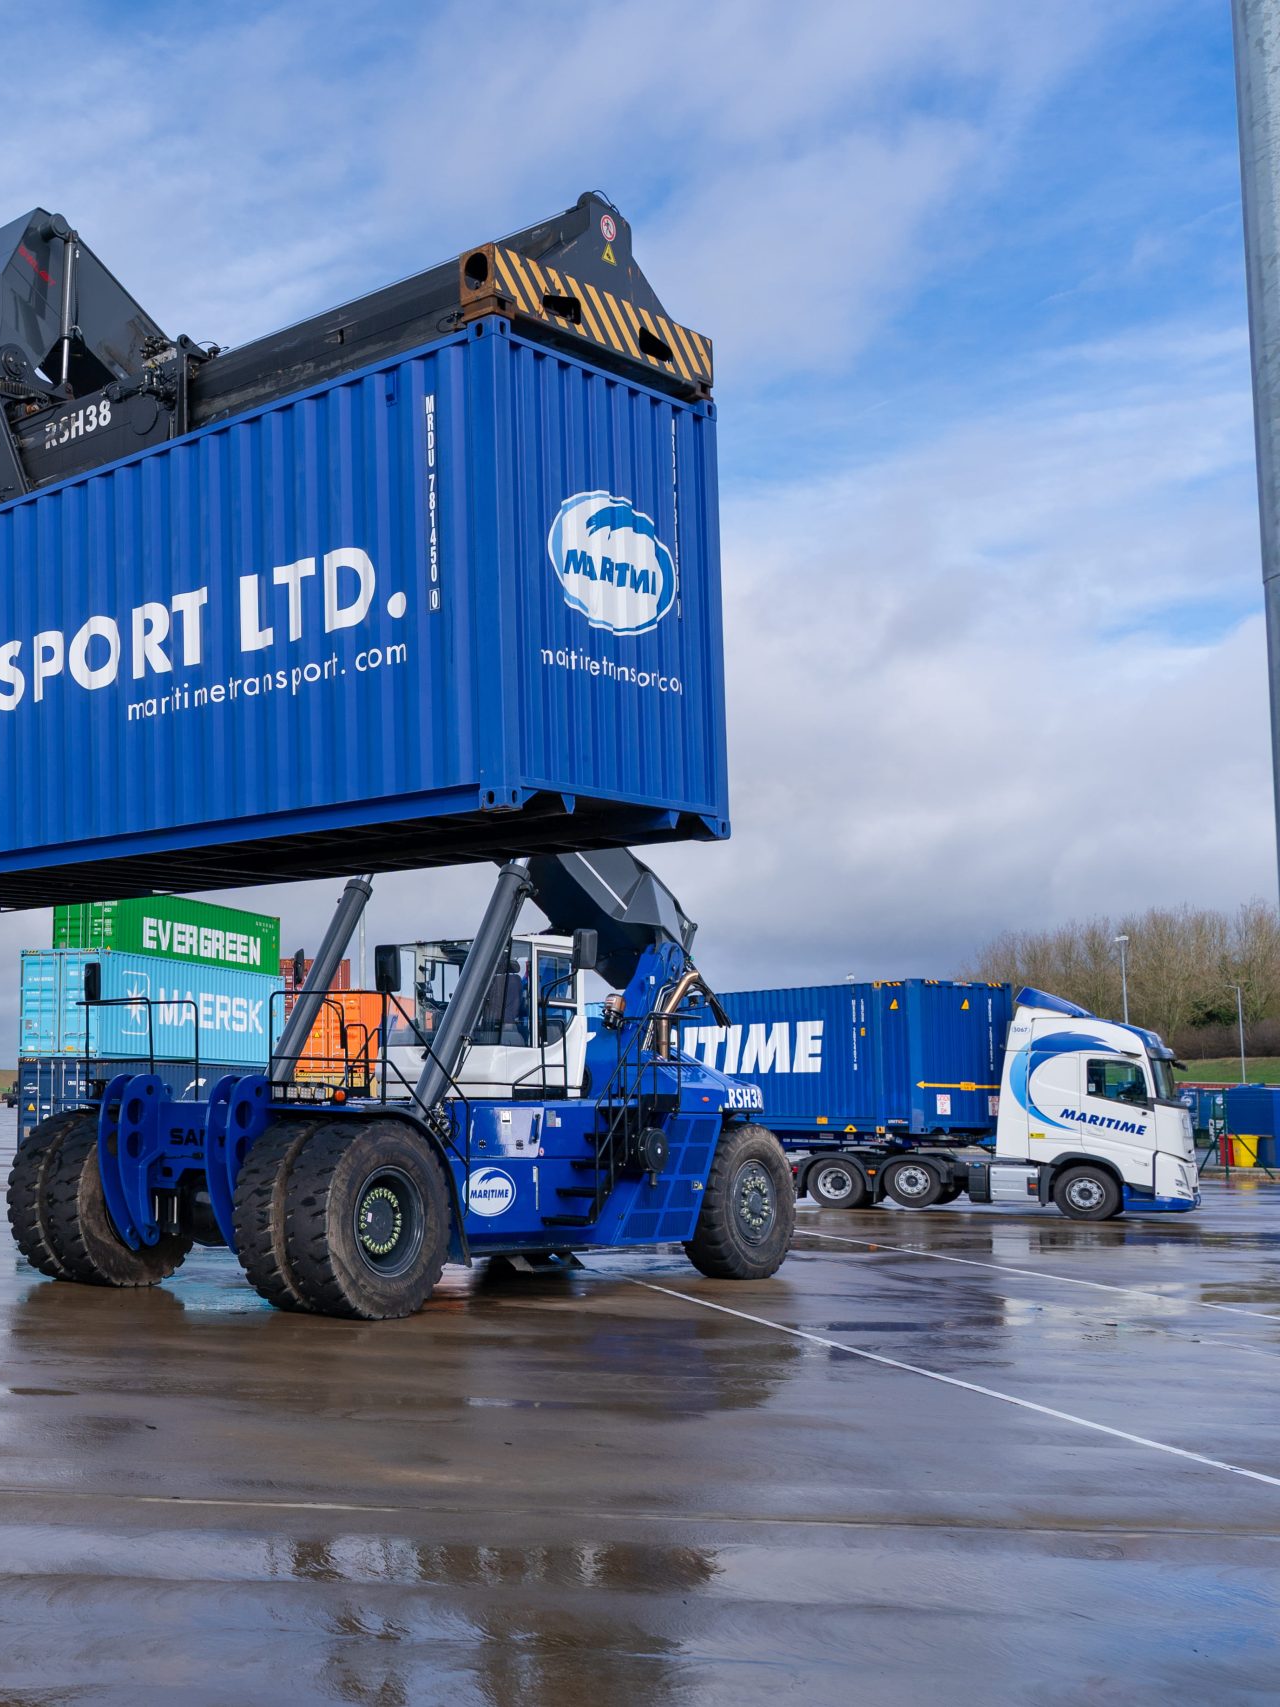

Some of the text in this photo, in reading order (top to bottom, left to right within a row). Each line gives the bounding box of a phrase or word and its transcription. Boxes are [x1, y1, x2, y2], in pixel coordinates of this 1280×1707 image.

[45, 400, 112, 449] RSH38
[425, 395, 435, 467] MRDU
[428, 474, 438, 582] 781450
[239, 547, 407, 652] LTD.
[142, 916, 261, 966] EVERGREEN
[158, 987, 264, 1034] MAERSK
[1059, 1108, 1147, 1136] MARITIME
[470, 1188, 509, 1199] MARITIME
